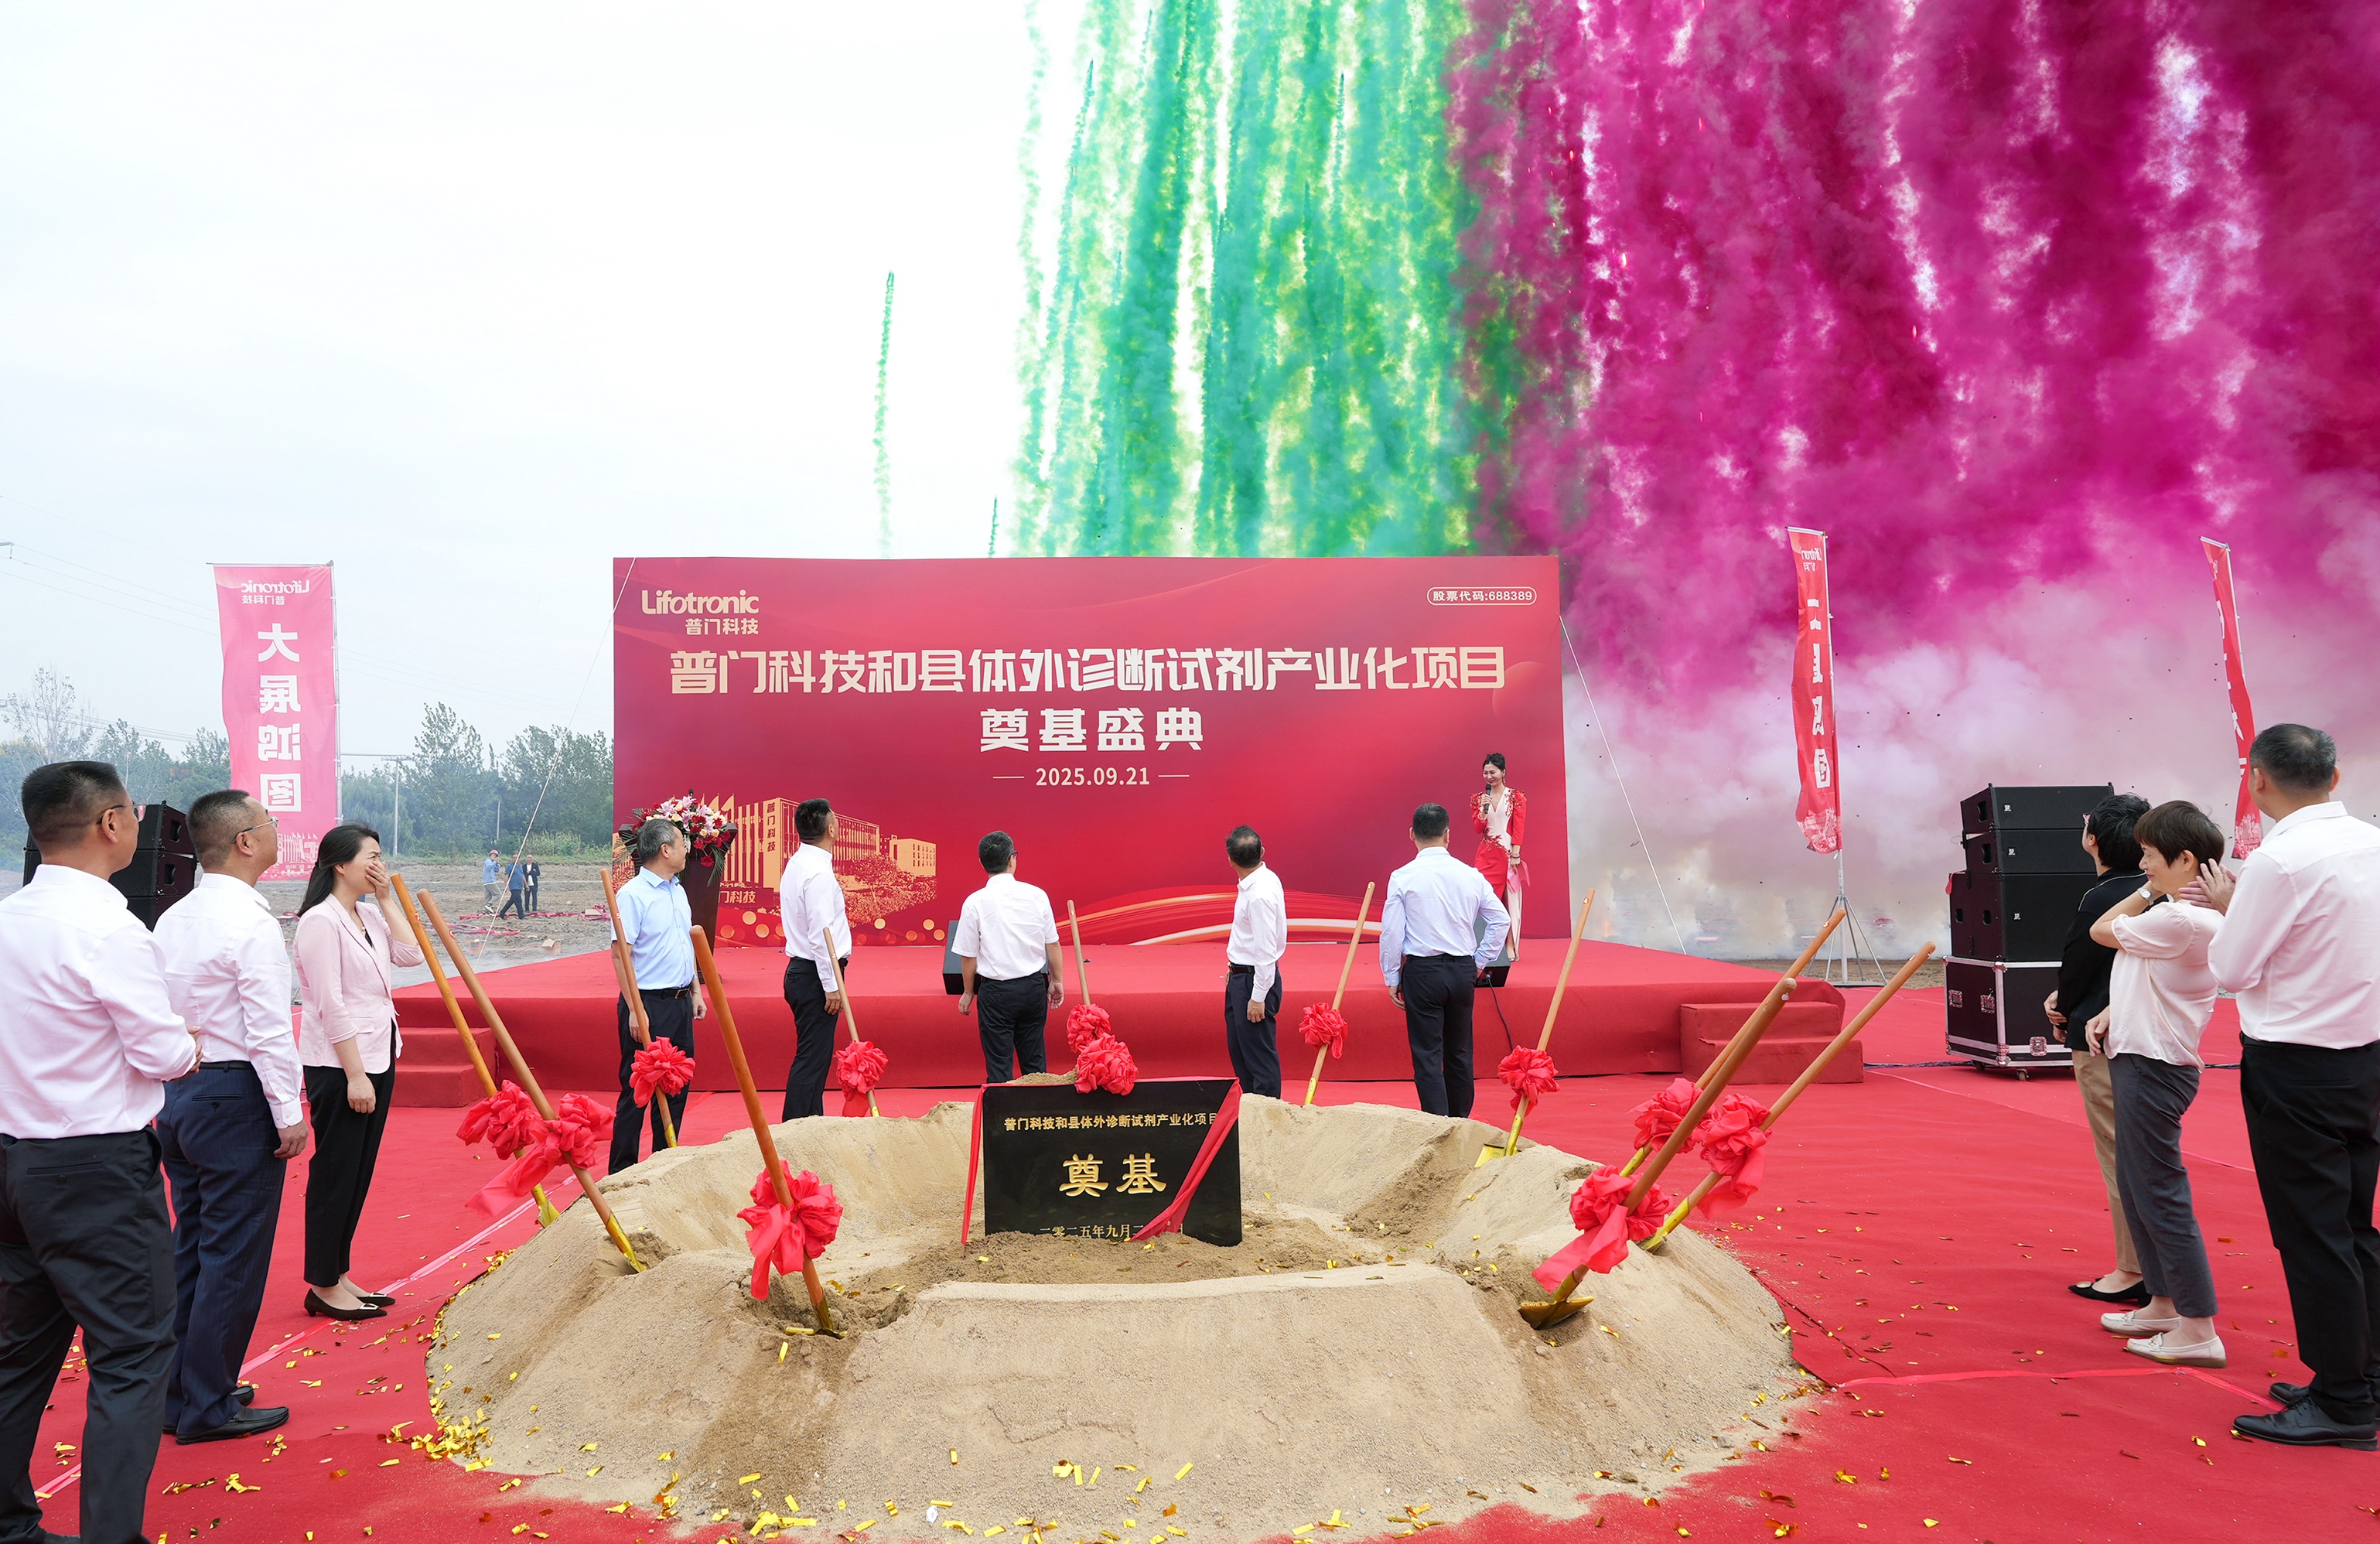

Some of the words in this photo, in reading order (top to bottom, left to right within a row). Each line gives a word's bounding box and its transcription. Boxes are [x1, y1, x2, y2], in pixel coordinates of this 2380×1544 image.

[641, 589, 760, 615] Lifotronic
[1432, 589, 1533, 603] 股票代码:688389
[685, 617, 759, 635] 普门科技
[670, 646, 1505, 695] 普门科技和县体外诊断试剂产业化项目
[980, 707, 1204, 753] 奠基盛典
[1035, 767, 1150, 786] 2025.09.21
[767, 802, 776, 852] 普门科技
[1004, 1112, 1217, 1132] 普门科技和县体外诊断试剂产业化项目
[1058, 1152, 1167, 1197] 奠基
